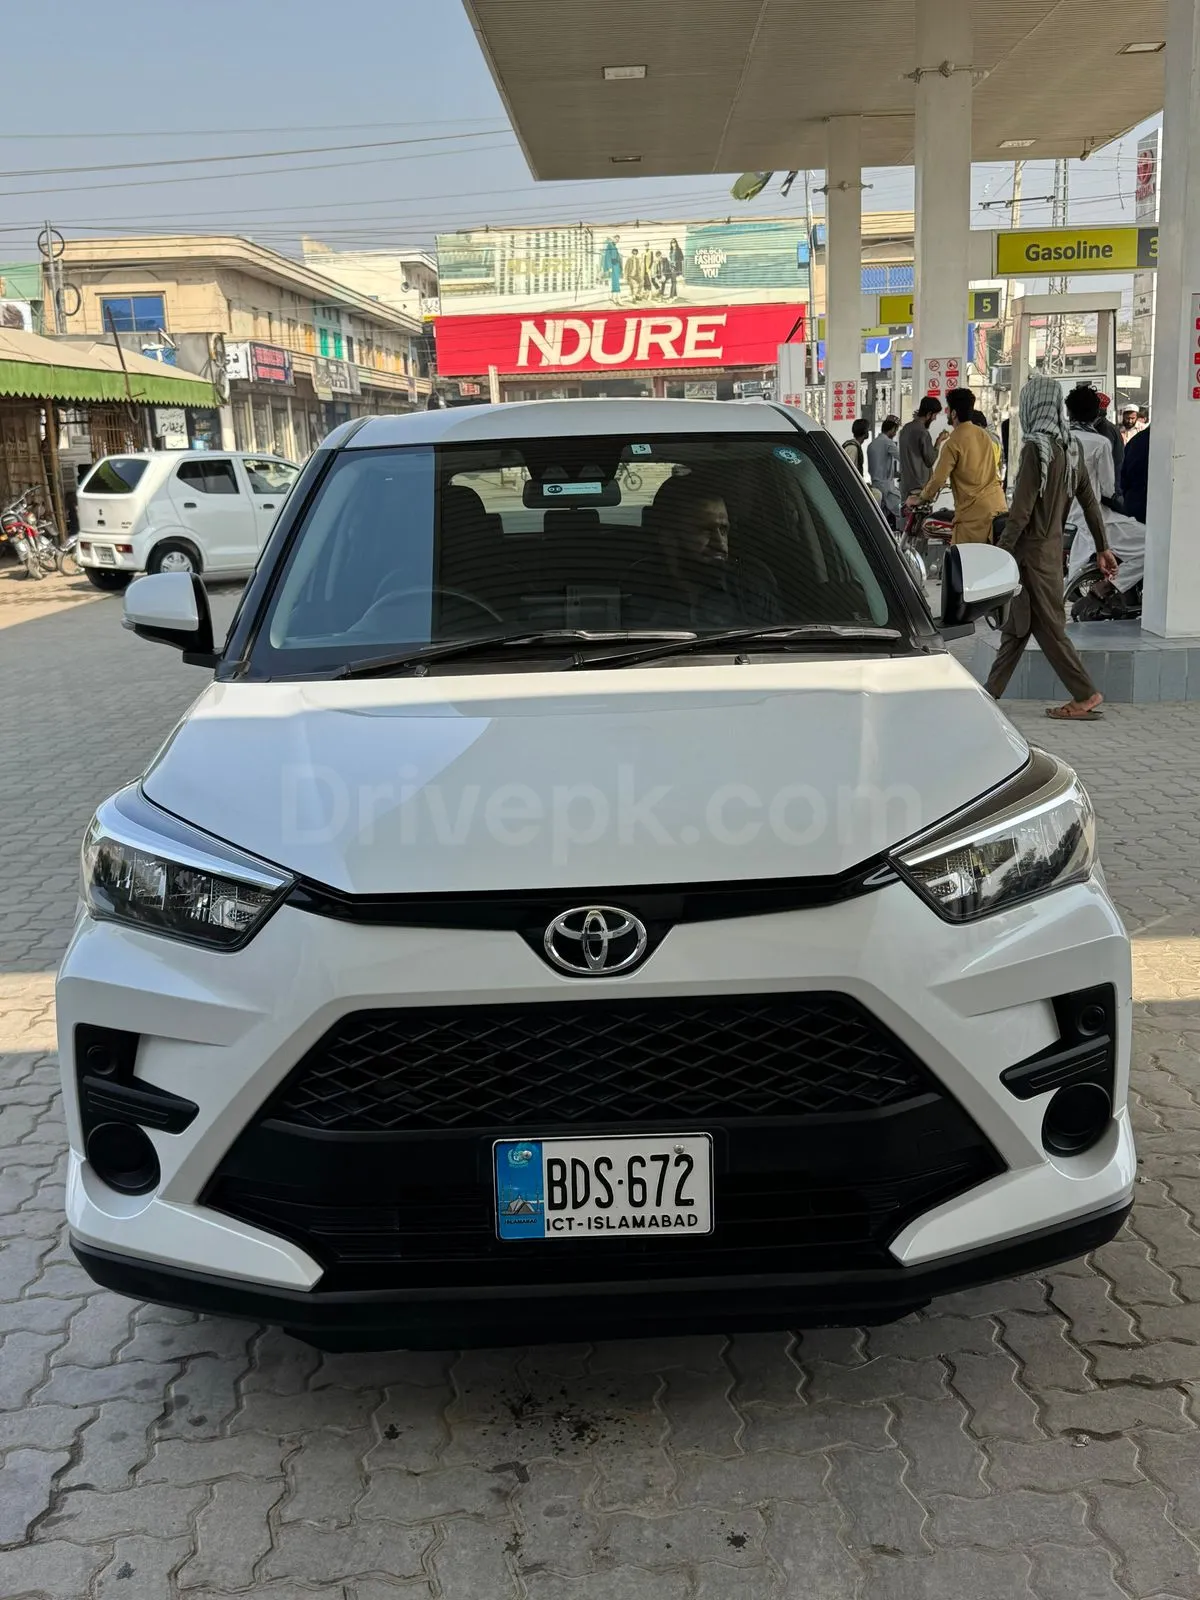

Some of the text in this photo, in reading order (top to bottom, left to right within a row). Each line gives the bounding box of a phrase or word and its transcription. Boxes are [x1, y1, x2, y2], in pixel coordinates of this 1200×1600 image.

[1025, 236, 1159, 262] Gasoline 3
[694, 254, 727, 265] FASHION
[702, 268, 719, 278] YOU
[982, 298, 992, 313] 5
[516, 313, 728, 367] NDURE
[546, 1214, 698, 1231] ICT-ISLAMABAD
